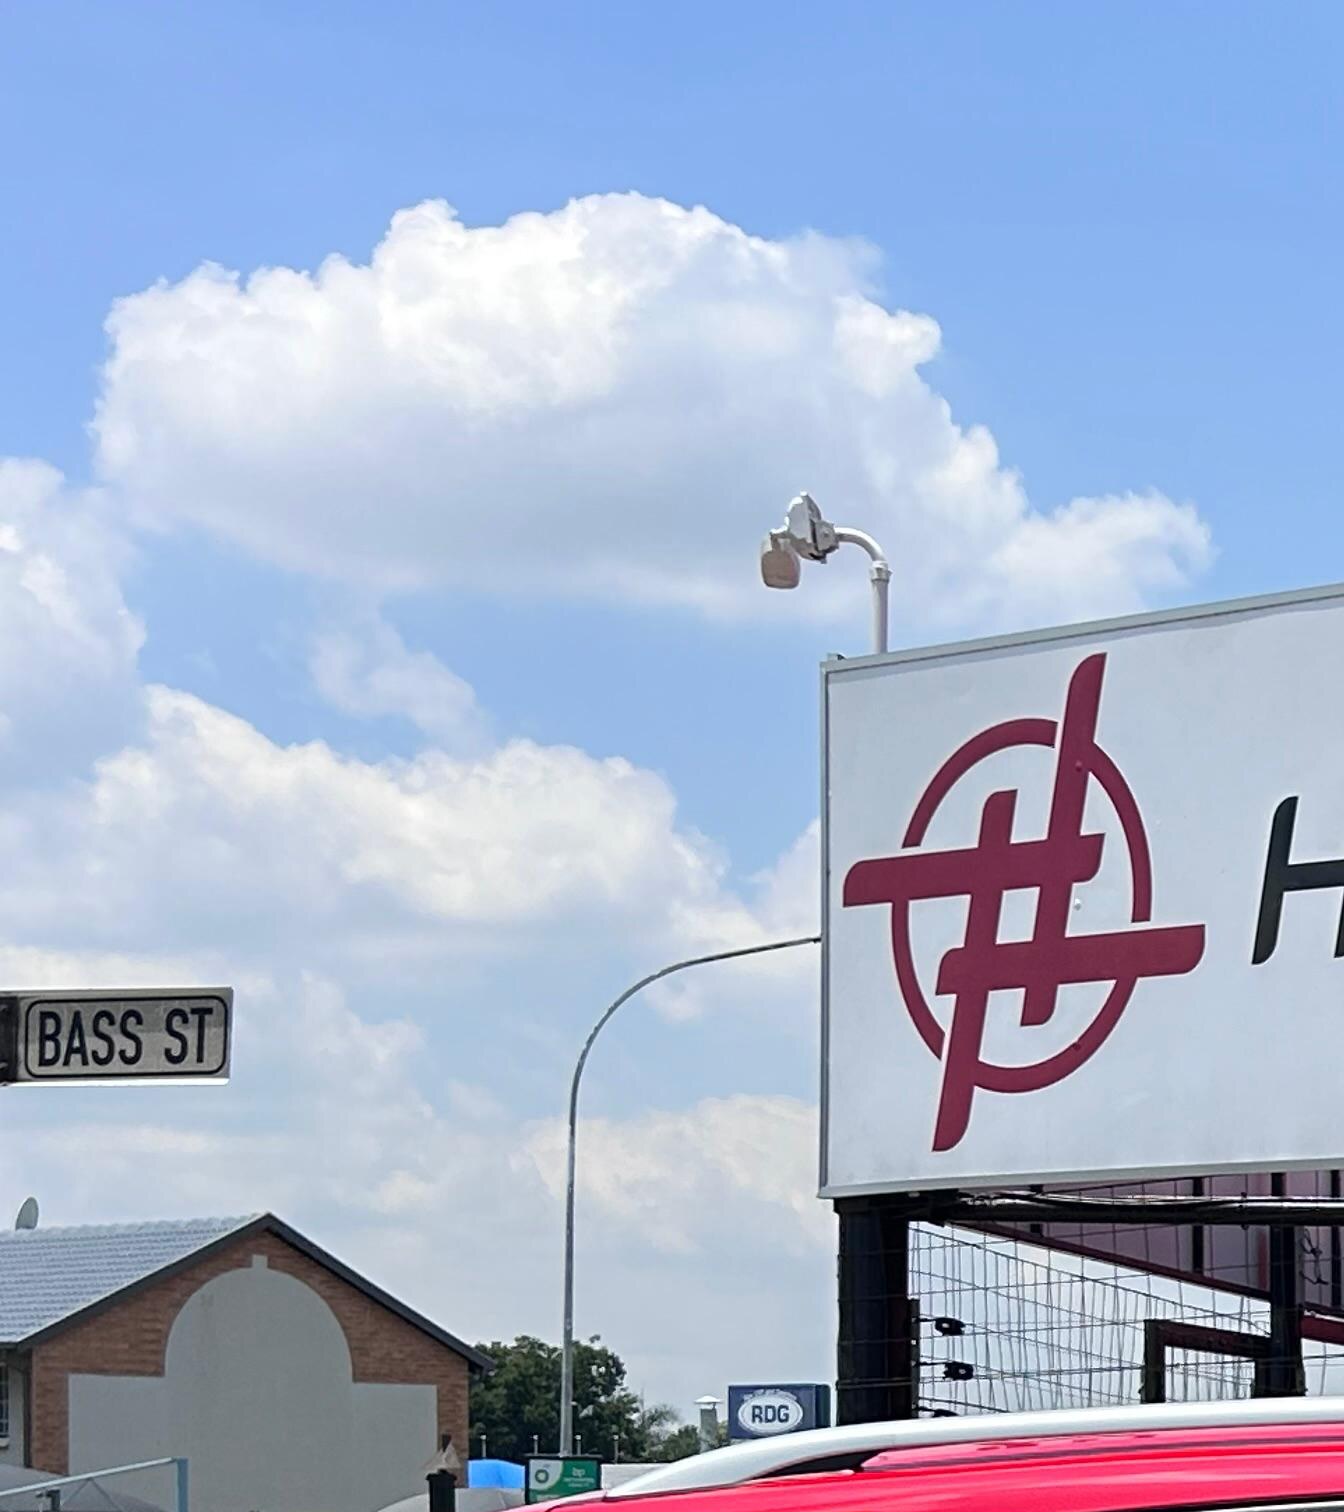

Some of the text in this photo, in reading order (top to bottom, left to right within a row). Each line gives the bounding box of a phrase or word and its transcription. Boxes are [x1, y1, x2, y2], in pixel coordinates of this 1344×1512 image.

[38, 1006, 213, 1067] BASS ST
[751, 1405, 790, 1424] RDG
